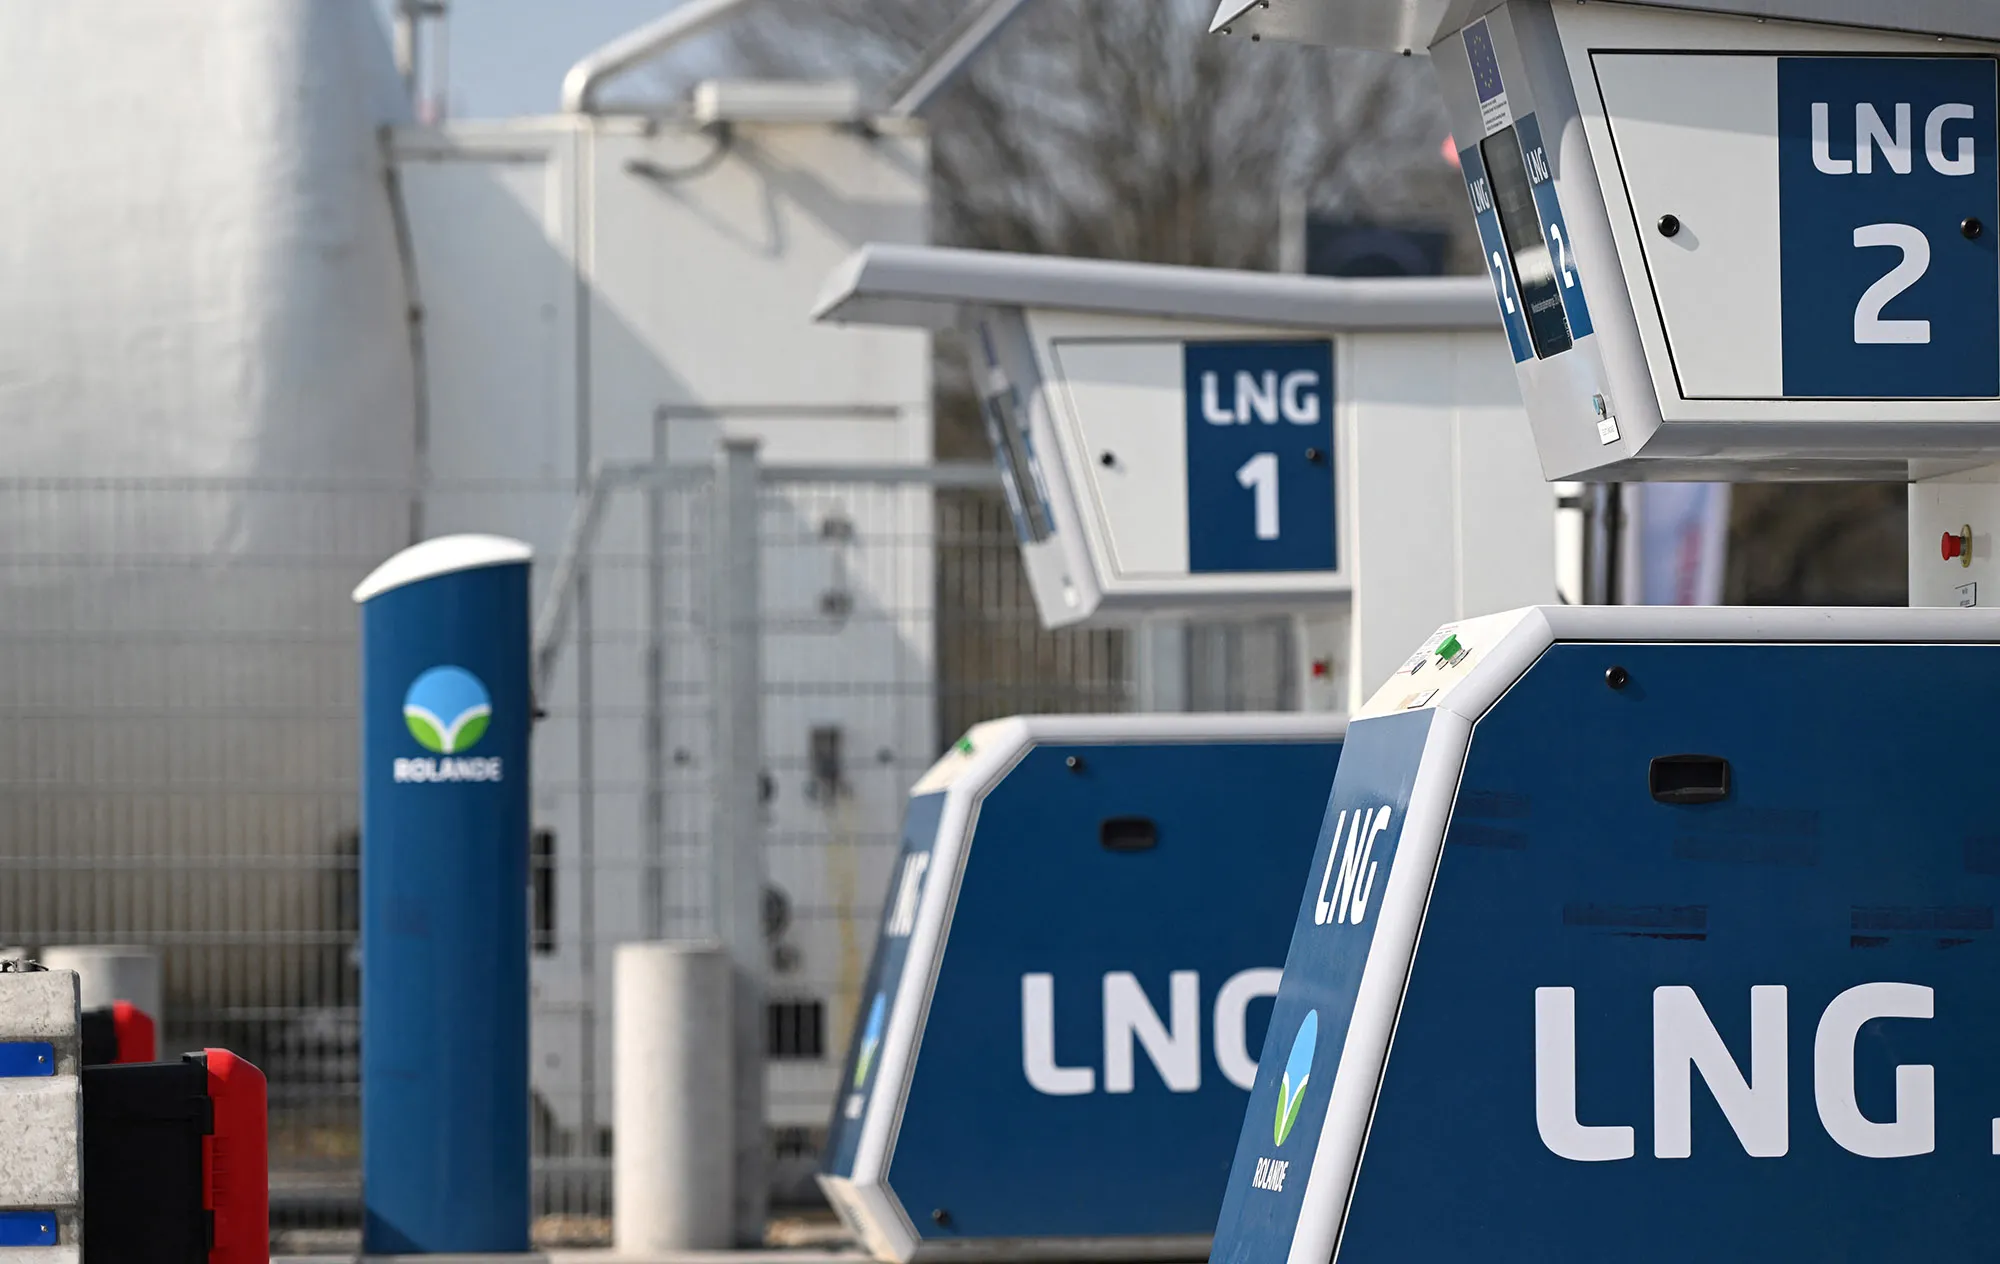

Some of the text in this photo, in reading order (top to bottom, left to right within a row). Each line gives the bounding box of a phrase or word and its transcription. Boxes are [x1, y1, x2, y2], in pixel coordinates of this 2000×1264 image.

[1527, 147, 1549, 184] LNG
[1812, 102, 1975, 175] LNG
[1470, 177, 1491, 214] LNG
[1492, 251, 1515, 314] 2
[1550, 223, 1575, 289] 2
[1853, 223, 1931, 344] 2
[1202, 371, 1320, 425] LNG
[1236, 452, 1280, 540] 1
[393, 756, 504, 783] ROLANDE
[1314, 805, 1392, 926] LNG
[1535, 982, 1935, 1162] LNG
[1252, 1157, 1290, 1192] ROLANDE
